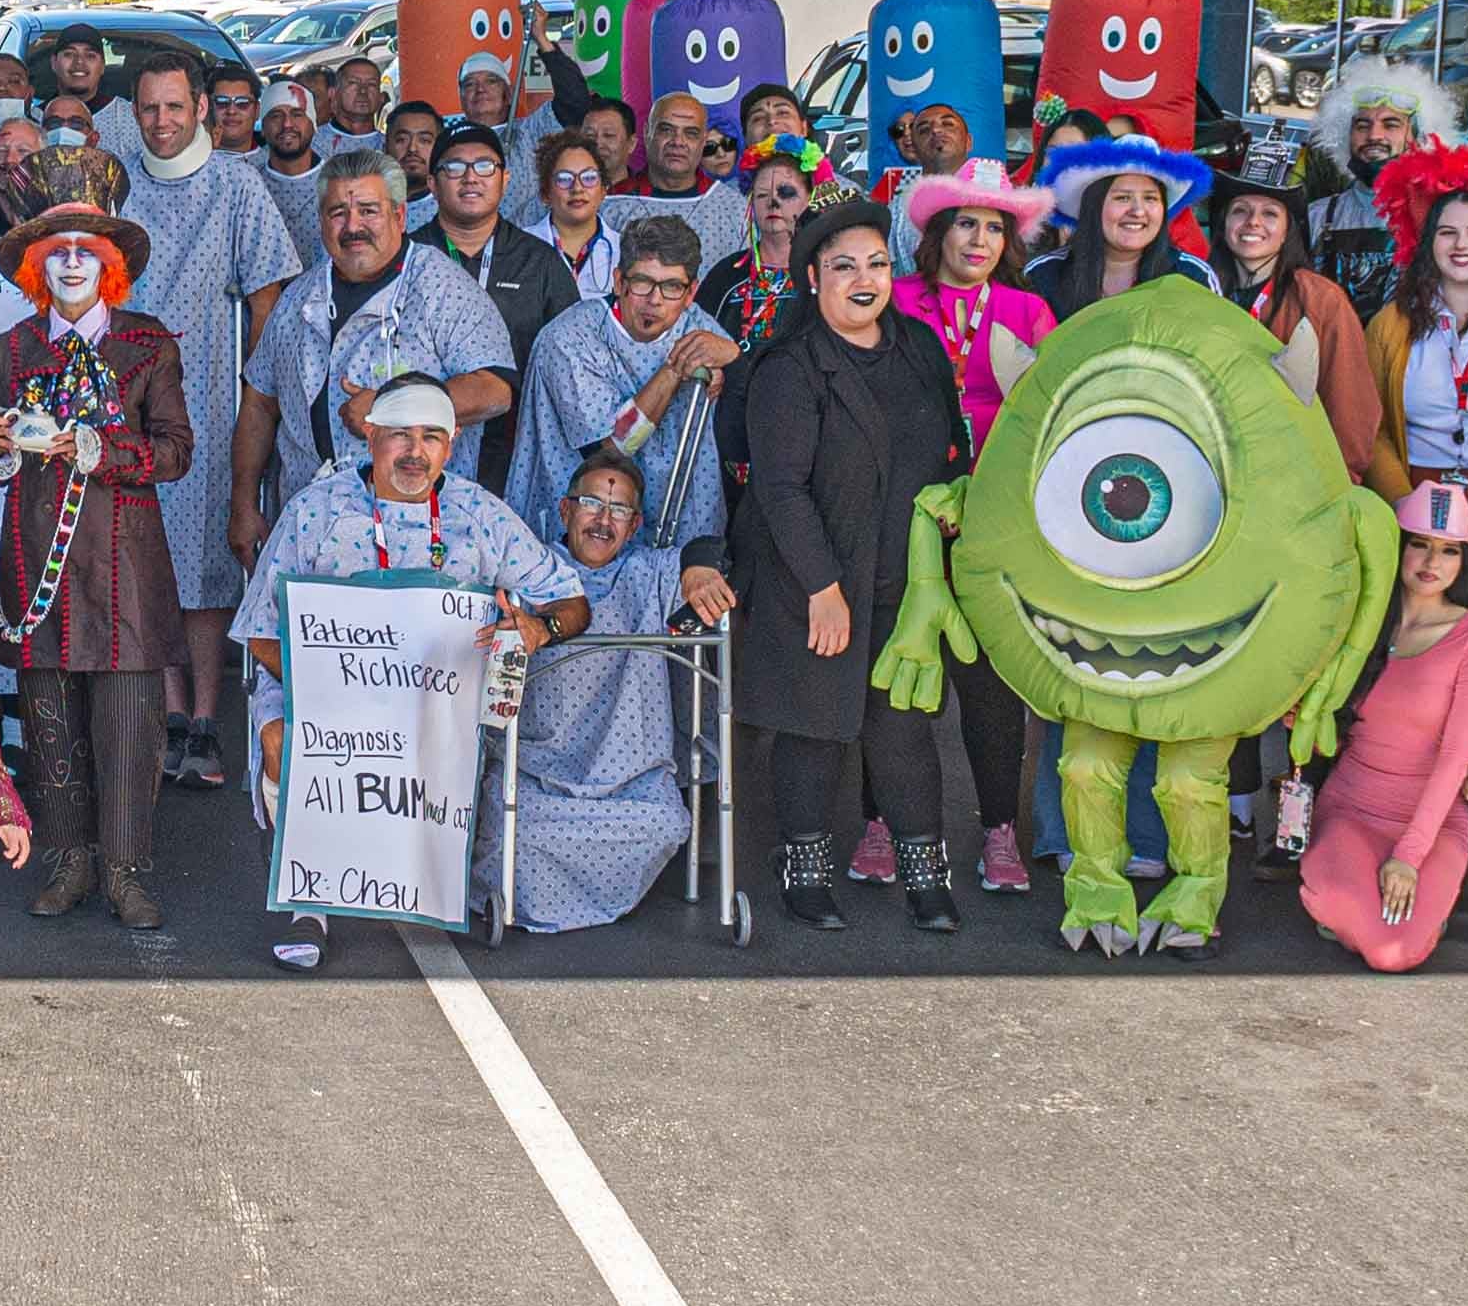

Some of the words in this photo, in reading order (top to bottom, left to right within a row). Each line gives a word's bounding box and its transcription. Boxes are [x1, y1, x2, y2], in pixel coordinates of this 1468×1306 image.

[300, 613, 405, 646] Patient:
[302, 721, 407, 766] Diagnosis:
[305, 776, 344, 813] All
[339, 867, 419, 912] Chau
